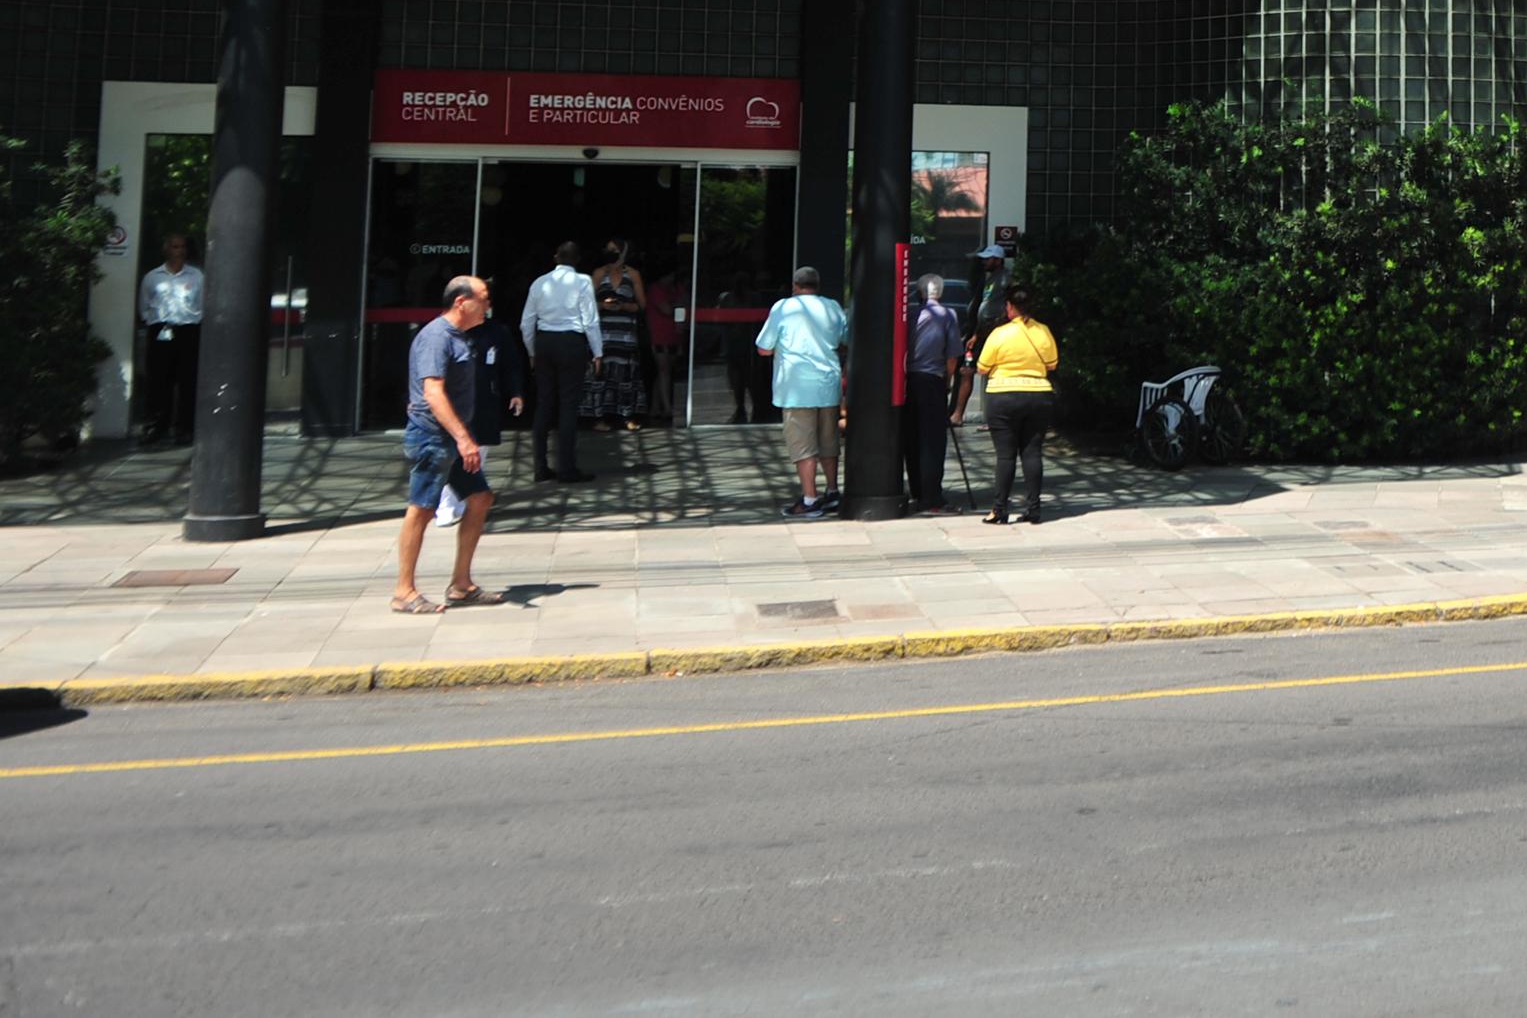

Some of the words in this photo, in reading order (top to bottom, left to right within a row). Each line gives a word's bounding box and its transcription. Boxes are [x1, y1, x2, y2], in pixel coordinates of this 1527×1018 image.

[402, 90, 489, 109] RECEPÇÃO
[529, 92, 633, 109] EMERGÊNCIA
[636, 95, 725, 112] CONVÊNIOS
[401, 107, 478, 122] CENTRAL
[528, 109, 539, 123] E
[543, 109, 640, 125] PARTICULAR
[422, 245, 470, 255] ENTRADA
